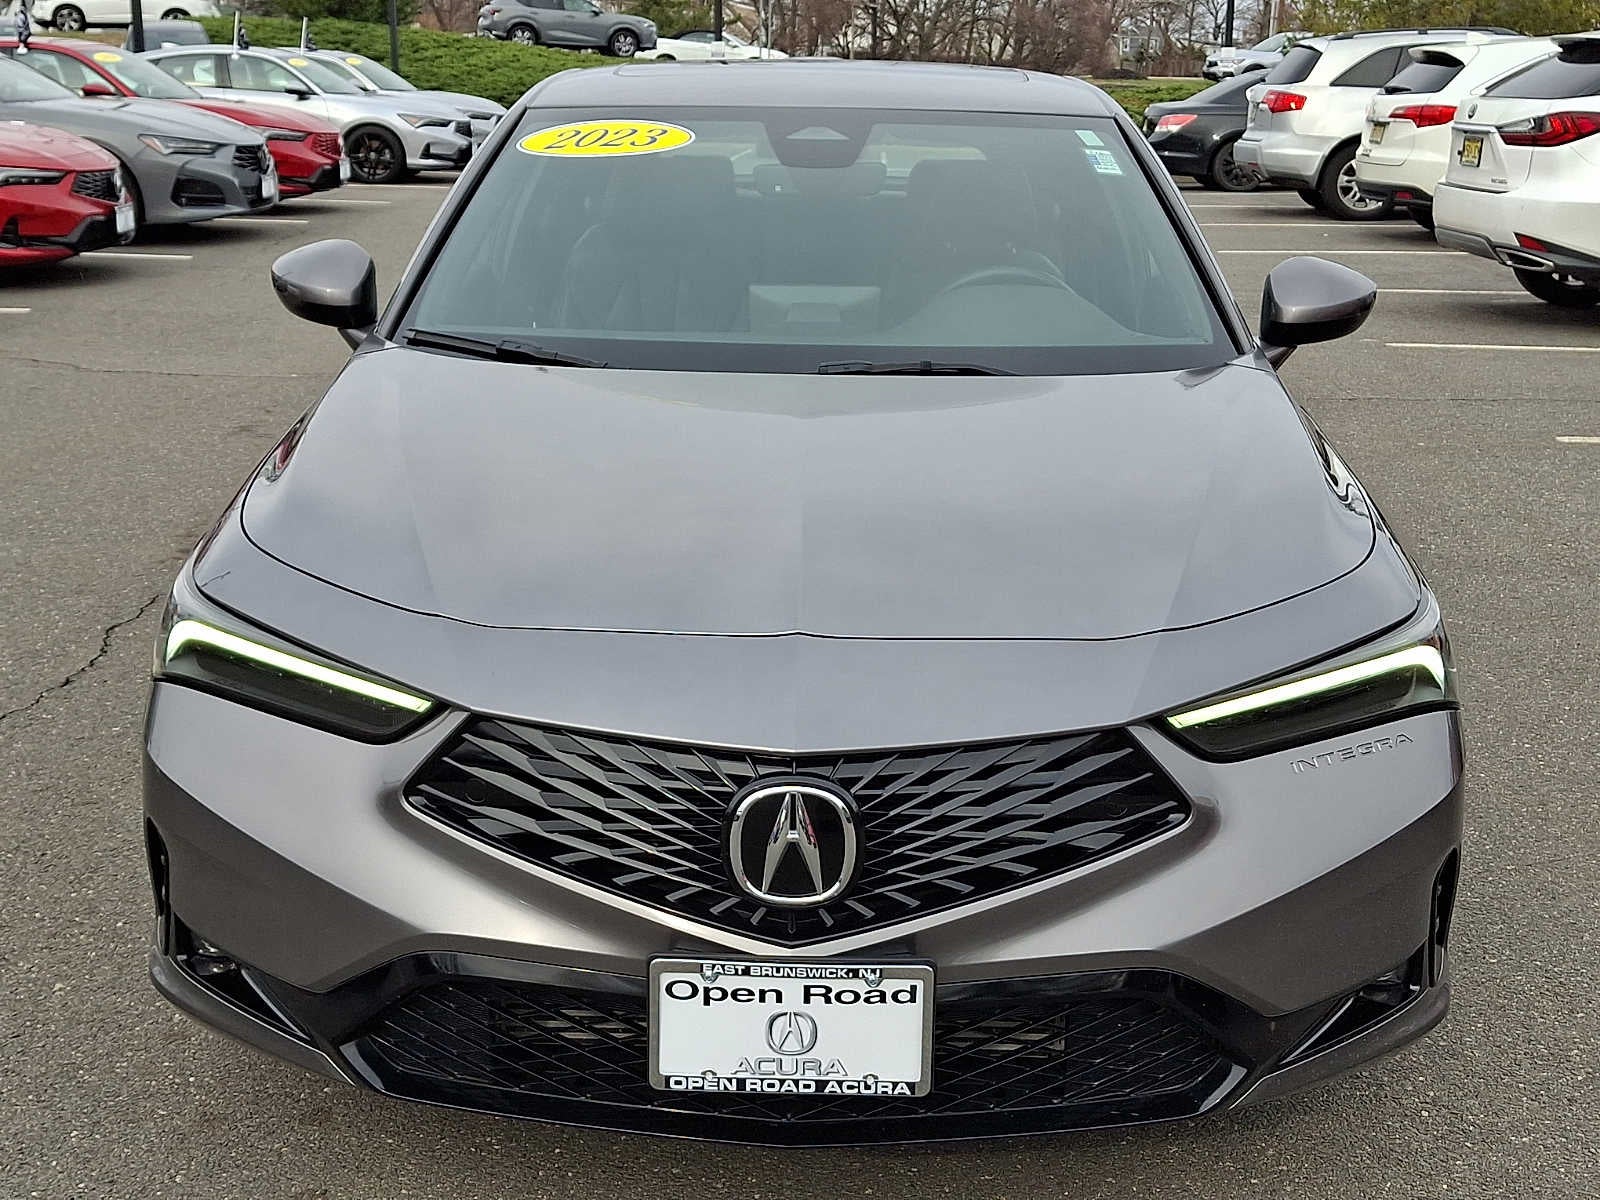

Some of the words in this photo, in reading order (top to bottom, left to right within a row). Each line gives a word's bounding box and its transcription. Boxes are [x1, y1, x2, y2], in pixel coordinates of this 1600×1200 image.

[544, 127, 668, 150] 2023
[1290, 733, 1414, 774] INTEGRA
[702, 963, 746, 976] EAST
[859, 968, 881, 980] NJ
[664, 979, 783, 1006] Open
[803, 984, 917, 1005] Road
[731, 1057, 848, 1076] ACURA
[669, 1076, 737, 1093] OPEN
[745, 1078, 816, 1094] ROAD
[823, 1080, 912, 1096] ACURA
